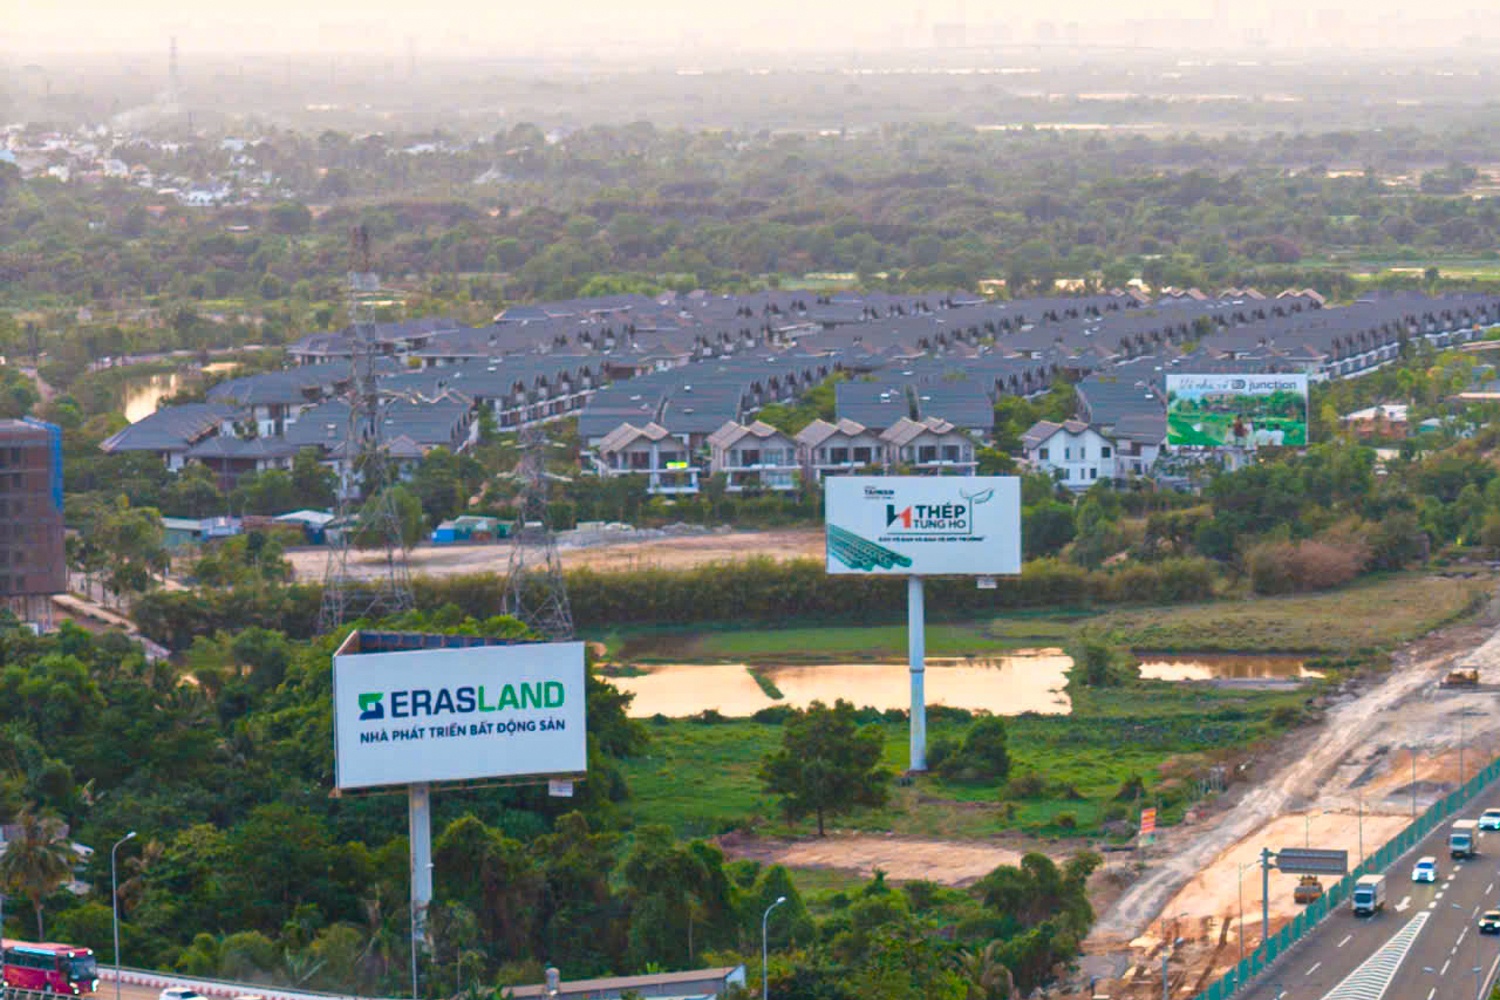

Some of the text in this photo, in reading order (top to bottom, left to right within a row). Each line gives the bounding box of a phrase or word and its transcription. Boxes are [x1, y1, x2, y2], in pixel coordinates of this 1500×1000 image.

[1249, 380, 1297, 391] junction
[914, 502, 966, 519] THÉP
[914, 520, 966, 529] TUNG HO
[390, 681, 565, 718] ERASLAND
[360, 716, 565, 743] NHÀ PHÁT TRIỂN BẤT ĐỘNG SẢN
